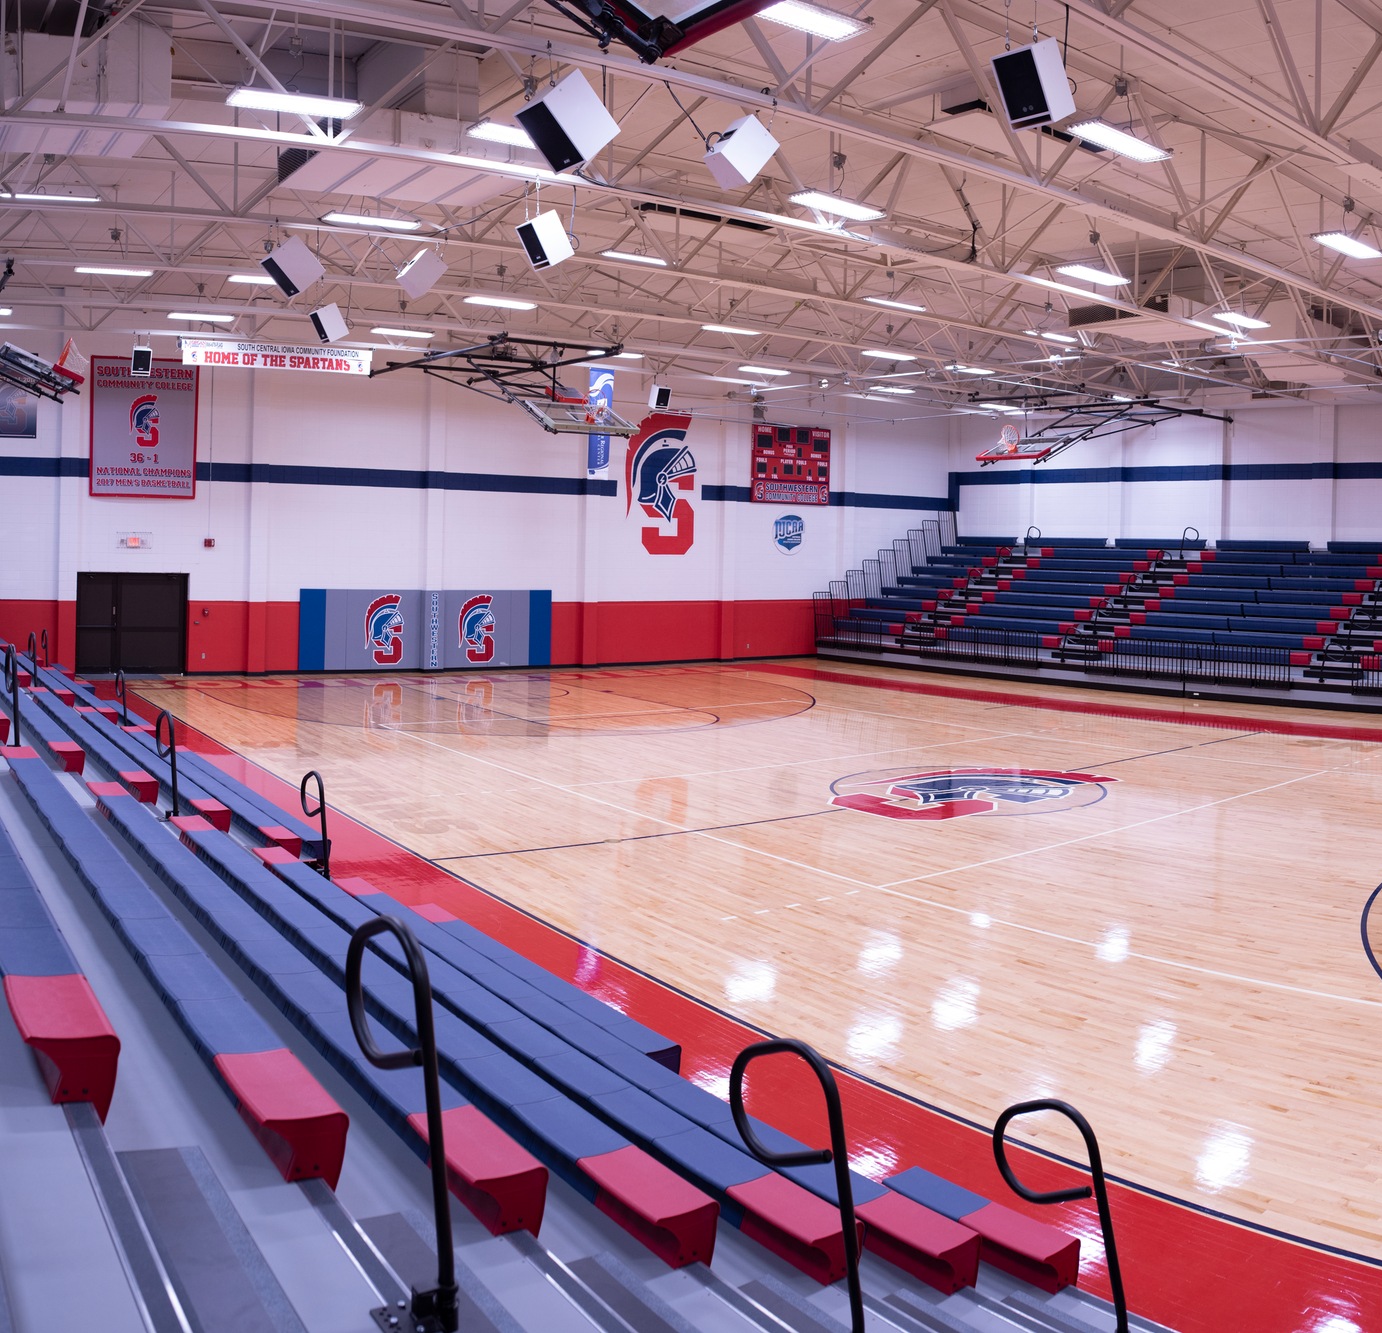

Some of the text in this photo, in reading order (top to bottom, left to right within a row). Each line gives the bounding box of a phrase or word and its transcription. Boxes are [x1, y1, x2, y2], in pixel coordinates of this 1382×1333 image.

[256, 345, 280, 353] CENTRAL
[281, 346, 295, 354] IOWA
[296, 347, 326, 356] COMMUNITY
[327, 349, 358, 358] FOUNDATION
[204, 352, 350, 371] HOME OF THE SPARTANS
[97, 379, 193, 391] COMMUNITY COLLEGE
[130, 453, 144, 463] 36
[154, 454, 159, 464] 1
[96, 467, 191, 478] NATIONAL CHAMPIONS
[116, 479, 139, 487] MEN'S
[141, 480, 190, 489] BASKETBALL
[766, 483, 818, 492] SOUTHWESTERN
[766, 492, 818, 502] COMMUNITY COLLEGE
[775, 521, 803, 539] NJCAA
[430, 593, 438, 668] SOUTHWESTERN
